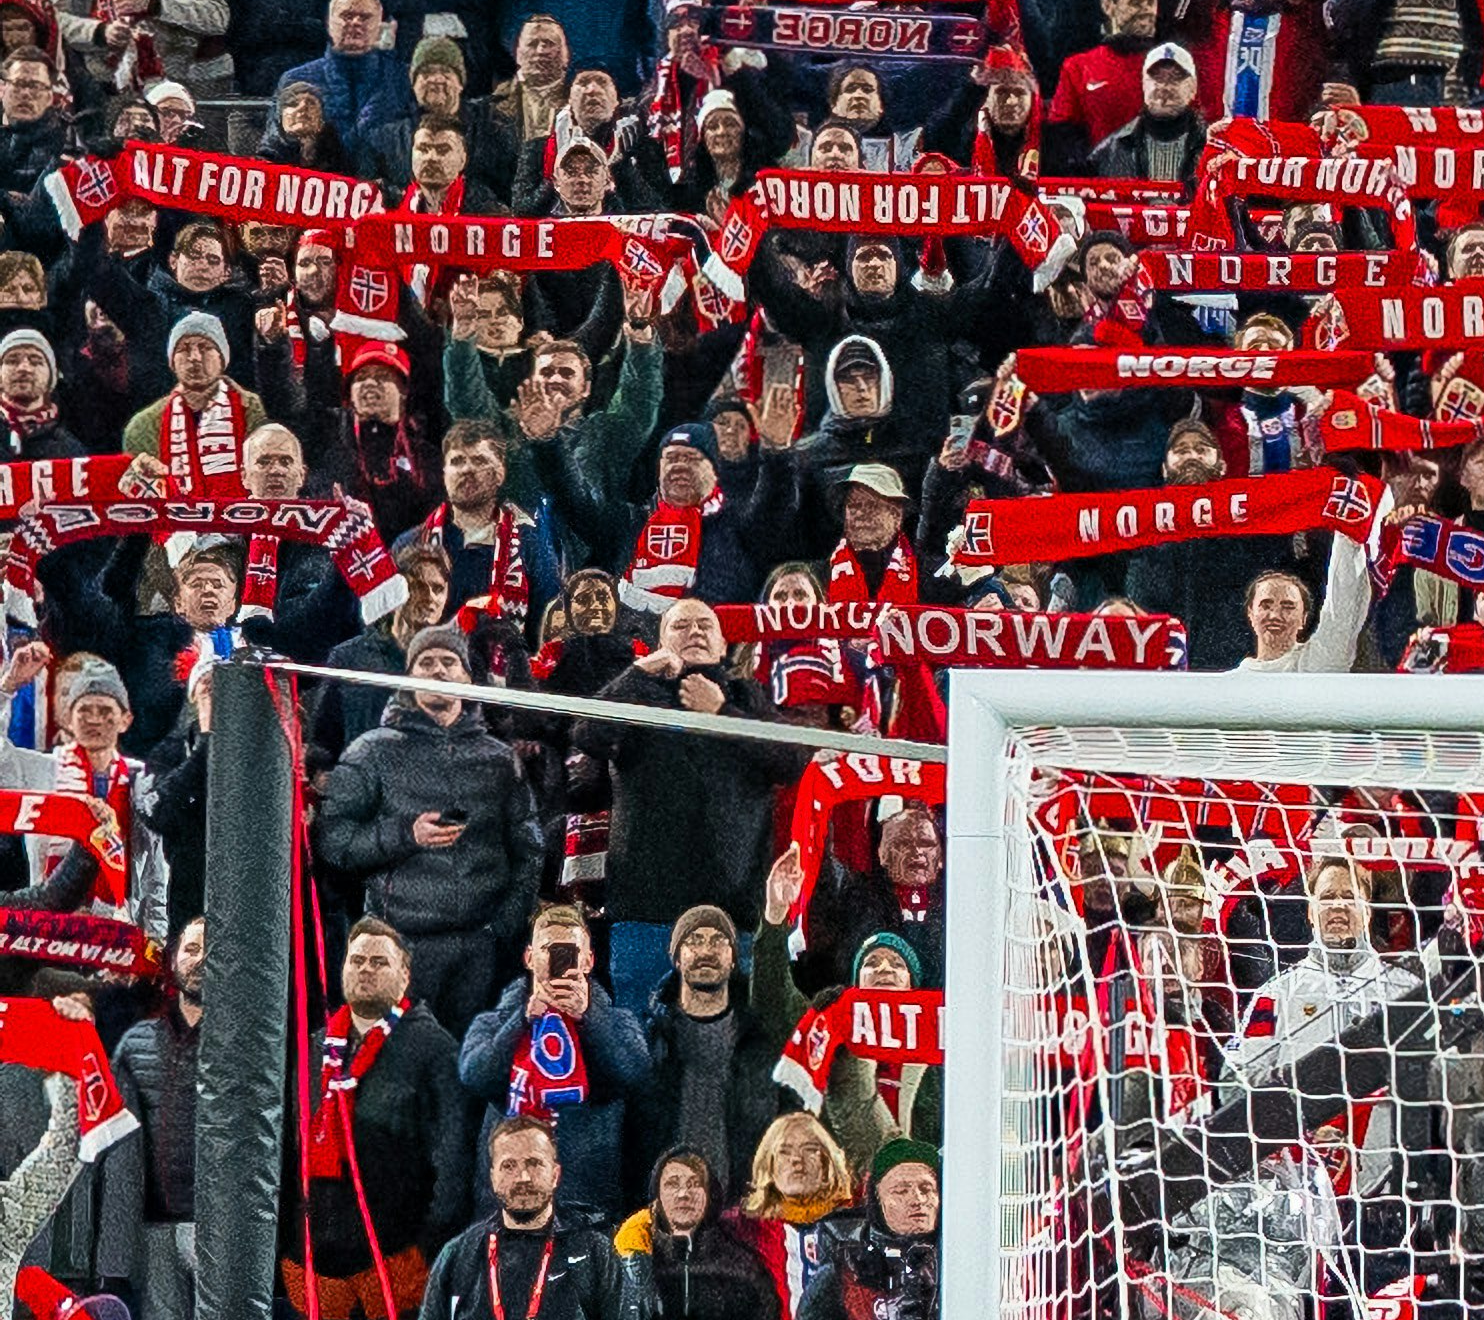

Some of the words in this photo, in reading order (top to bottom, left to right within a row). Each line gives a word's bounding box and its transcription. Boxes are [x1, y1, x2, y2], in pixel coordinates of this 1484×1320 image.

[134, 150, 191, 196] ALT
[198, 162, 265, 211] FOR
[874, 183, 939, 225] FOR
[952, 183, 1011, 224] ALT
[396, 220, 556, 260] NORGE
[1170, 253, 1389, 289] NORGE
[1117, 354, 1279, 380] NORGE
[1077, 494, 1249, 543] NORGE
[878, 610, 1162, 665] NORWAY
[852, 1000, 920, 1051] ALT
